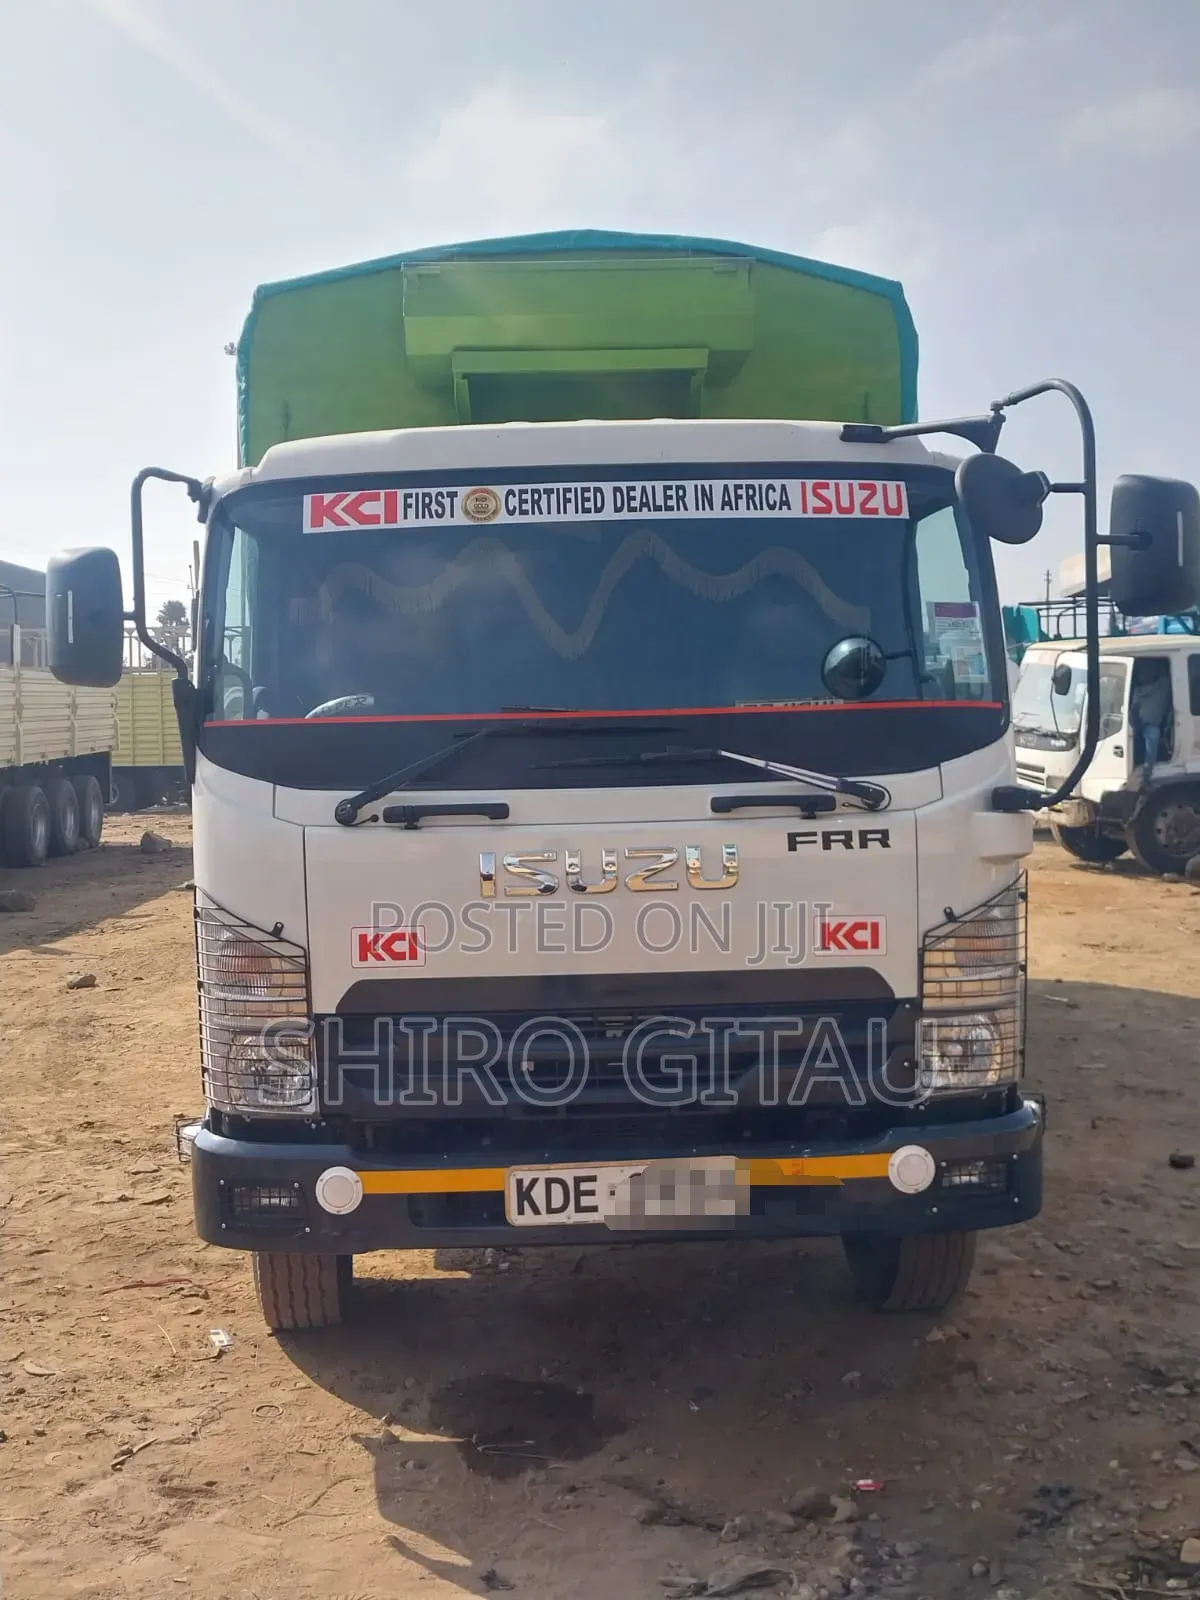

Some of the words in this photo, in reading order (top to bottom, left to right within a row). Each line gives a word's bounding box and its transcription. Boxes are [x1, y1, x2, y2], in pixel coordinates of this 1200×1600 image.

[310, 490, 398, 528] KCI
[403, 491, 458, 520] FIRST
[504, 486, 606, 517] CERTIFIED
[612, 485, 688, 513] DEALER
[694, 484, 714, 512] IN
[720, 483, 792, 512] AFRICA
[800, 481, 904, 516] ISUZU
[787, 829, 892, 852] FRR
[479, 843, 740, 898] ISUZU
[357, 932, 419, 962] KCI
[821, 921, 880, 951] KCI
[515, 1174, 599, 1216] KDE
